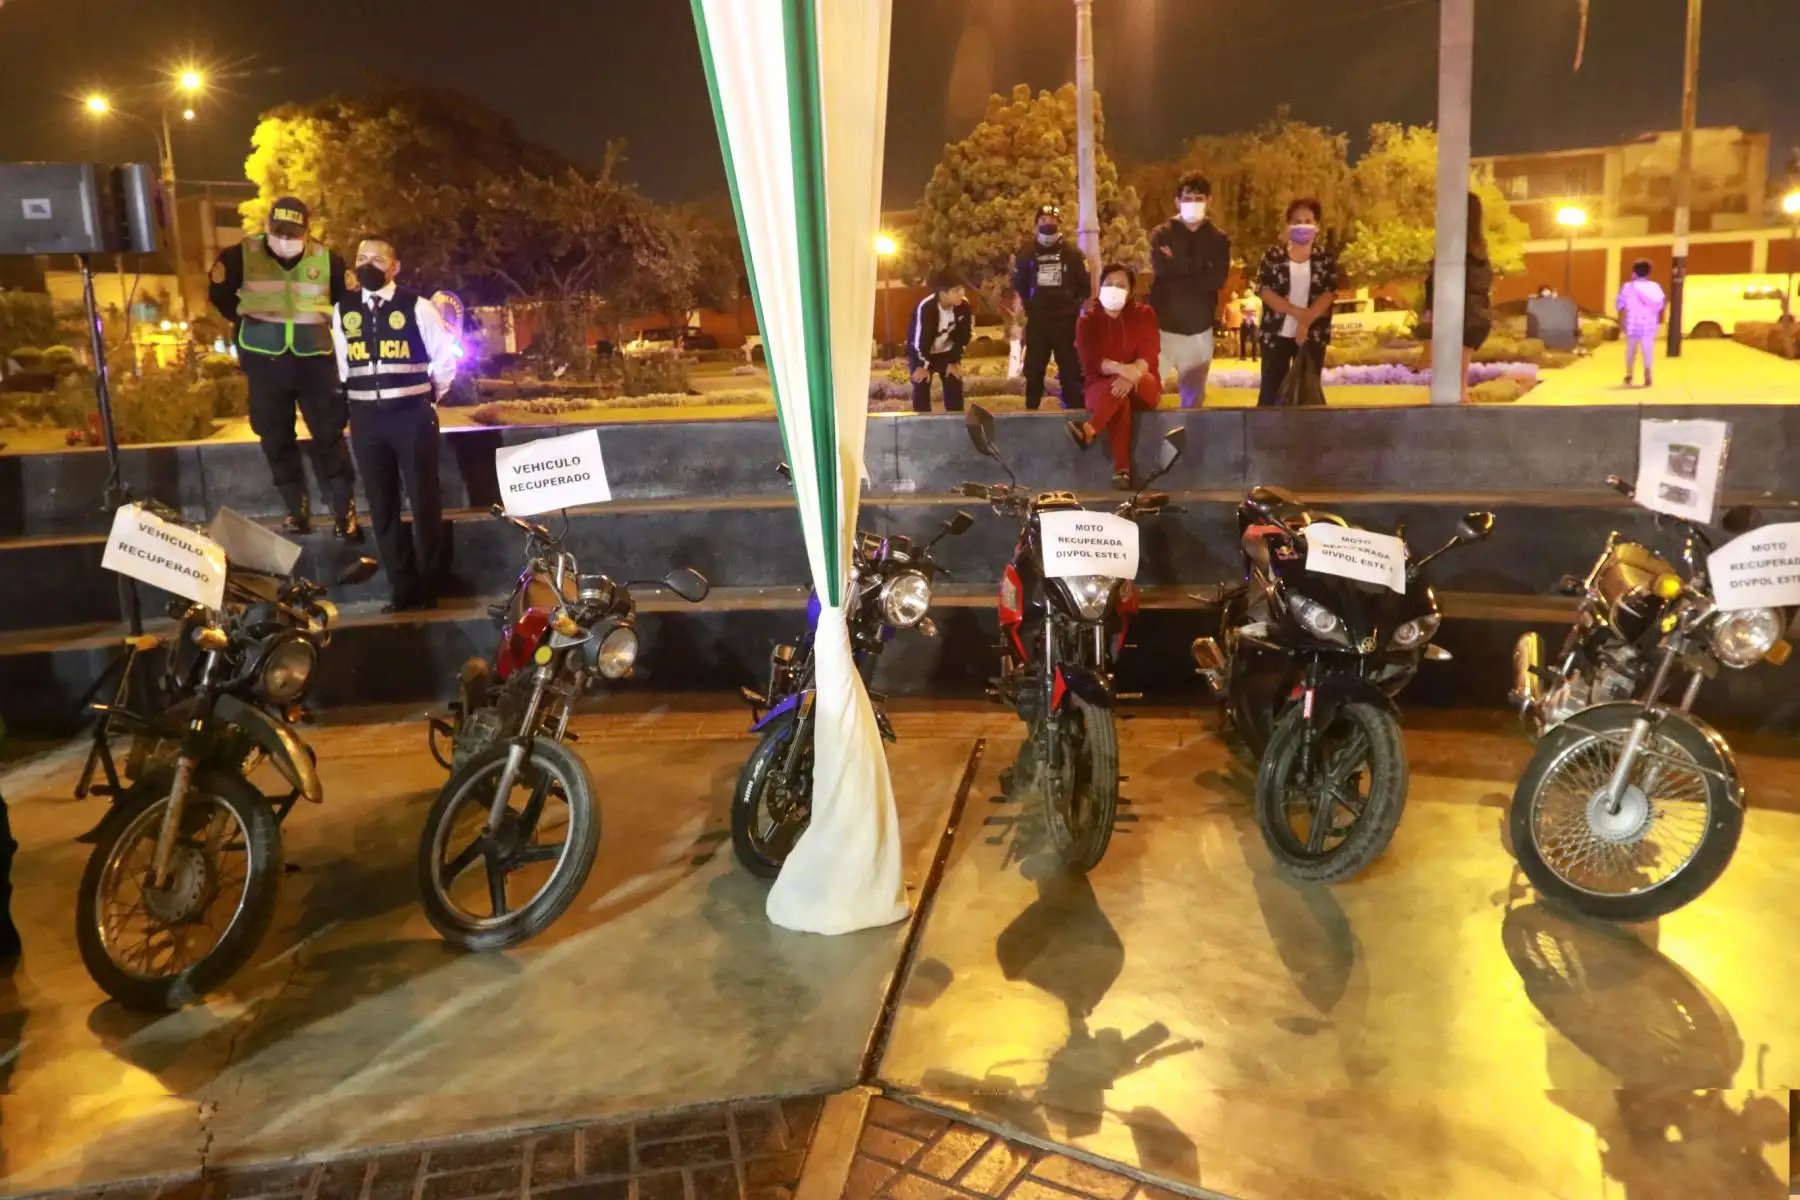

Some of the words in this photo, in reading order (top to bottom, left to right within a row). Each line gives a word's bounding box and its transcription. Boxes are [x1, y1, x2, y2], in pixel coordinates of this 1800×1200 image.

[512, 456, 581, 475] VEHICULO
[509, 472, 591, 493] RECUPERADO
[1075, 524, 1104, 532] MOTO
[138, 522, 204, 557] VEHICULO
[1058, 536, 1123, 546] RECUPERADA
[1752, 542, 1787, 552] MOTO
[118, 541, 209, 584] RECUPERADO
[1095, 551, 1119, 559] ESTE
[1322, 550, 1358, 564] DIVPOL
[1361, 558, 1385, 569] ESTE
[1730, 577, 1774, 588] DIVPOL
